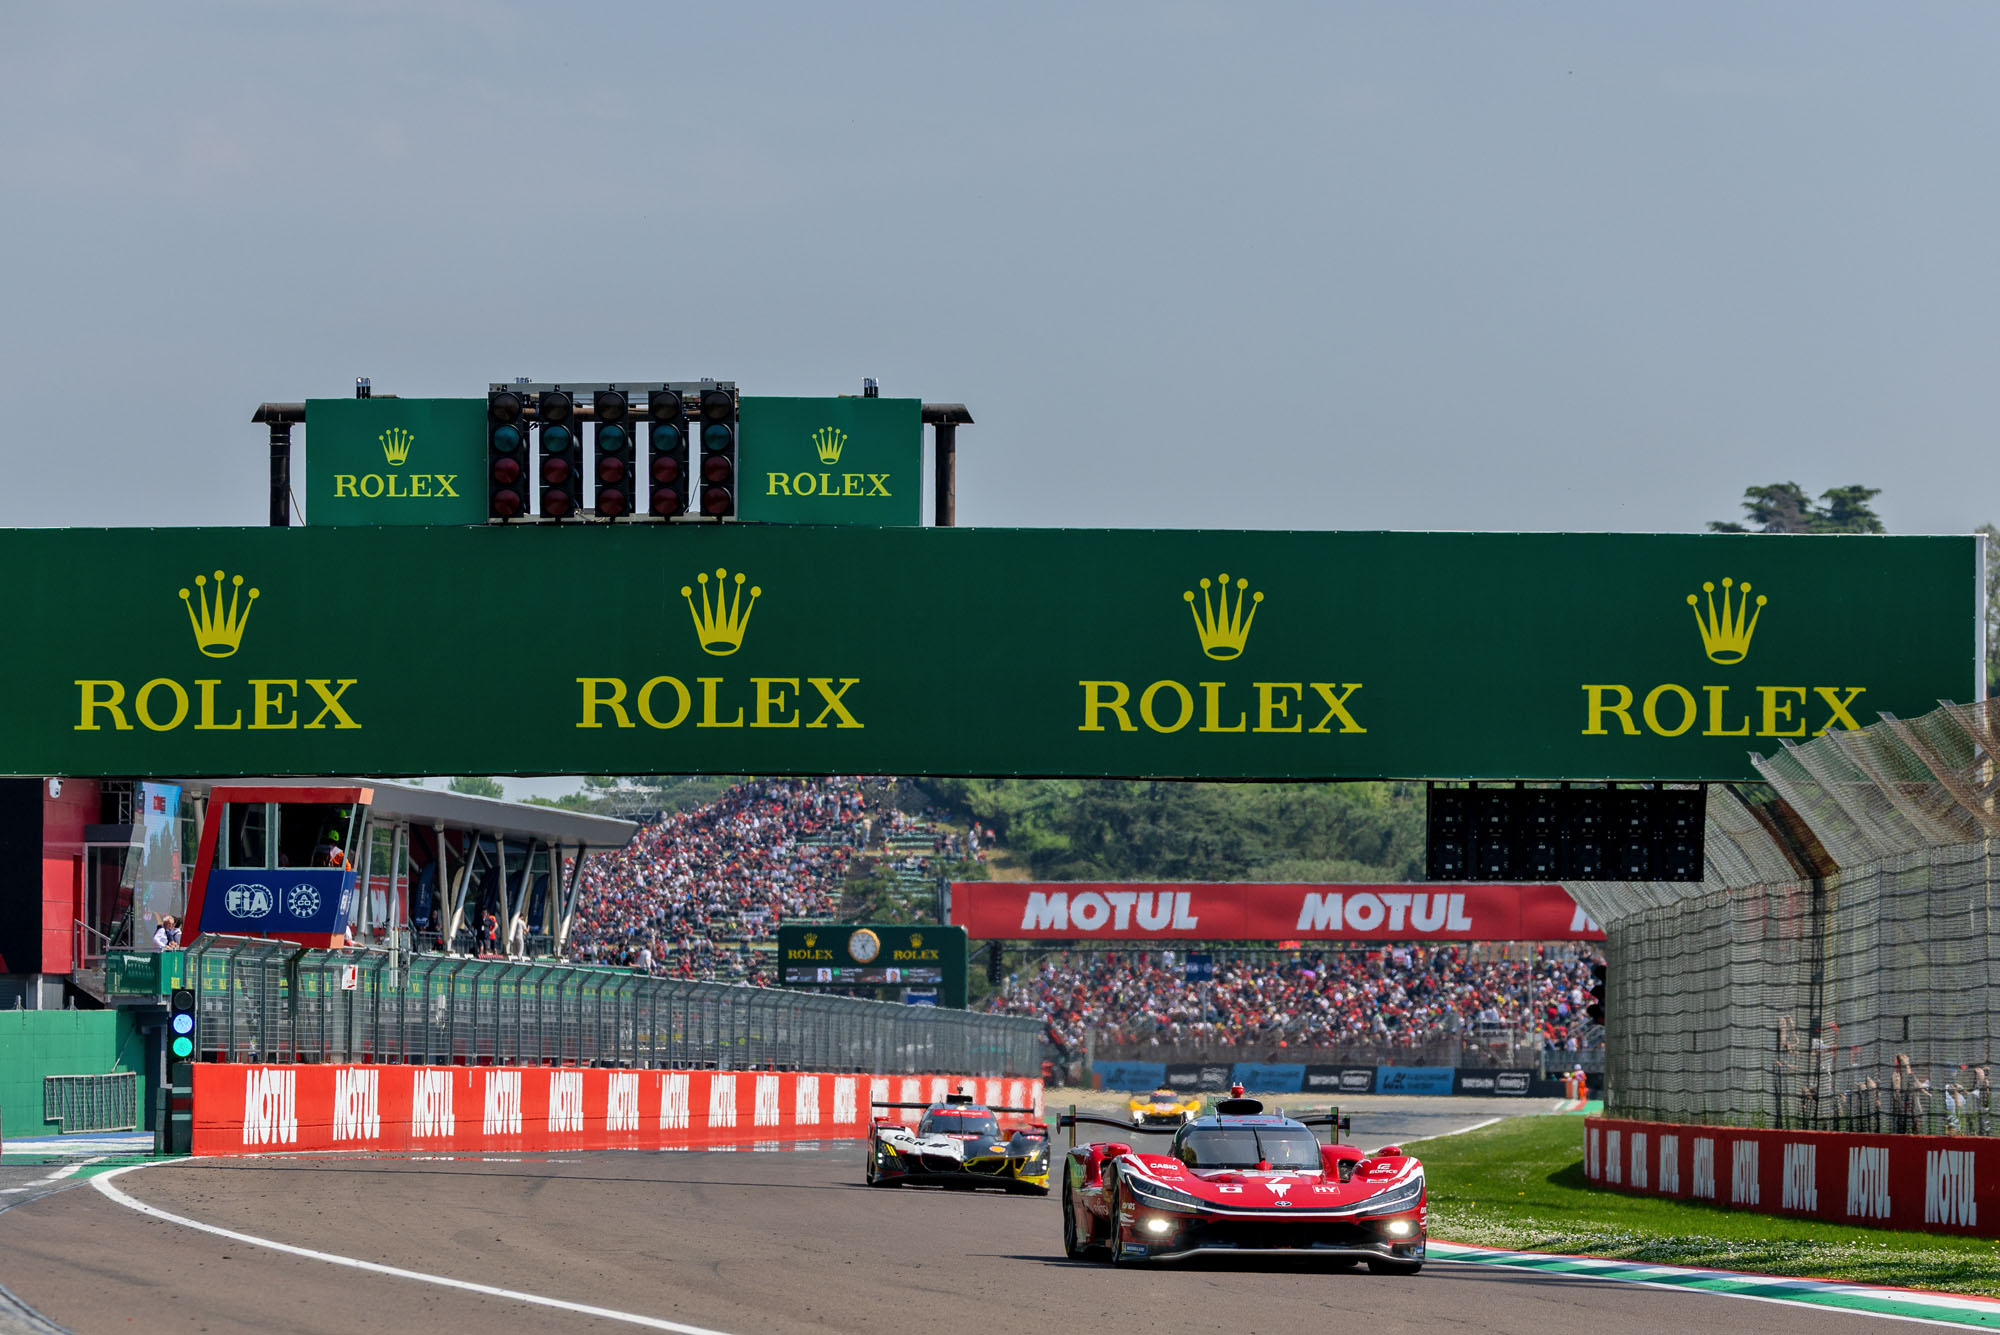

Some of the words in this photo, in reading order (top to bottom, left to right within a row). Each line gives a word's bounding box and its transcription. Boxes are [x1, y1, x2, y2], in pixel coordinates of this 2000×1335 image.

[334, 473, 459, 498] ROLEX
[766, 472, 891, 497] ROLEX
[74, 678, 362, 732] ROLEX
[575, 676, 865, 729] ROLEX
[1078, 680, 1367, 734] ROLEX
[1581, 683, 1868, 737] ROLEX
[1021, 892, 1198, 931] MOTUL
[1296, 893, 1472, 931] MOTUL
[788, 949, 833, 960] ROLEX
[893, 949, 939, 961] ROLEX
[243, 1067, 298, 1144] MOTUL
[333, 1067, 380, 1140] MOTUL
[412, 1068, 455, 1137] MOTUL
[483, 1071, 522, 1135] MOTUL
[548, 1071, 583, 1132] MOTUL
[607, 1071, 639, 1131] MOTUL
[660, 1072, 689, 1129] MOTUL
[708, 1073, 737, 1127] MOTUL
[894, 1134, 926, 1146] GEN
[1149, 1163, 1178, 1171] CASIO
[1693, 1137, 1715, 1198] MOTUL
[1732, 1140, 1760, 1205] MOTUL
[1782, 1143, 1818, 1211] MOTUL
[1847, 1146, 1891, 1218] MOTUL
[1925, 1149, 1977, 1226] MOTUL
